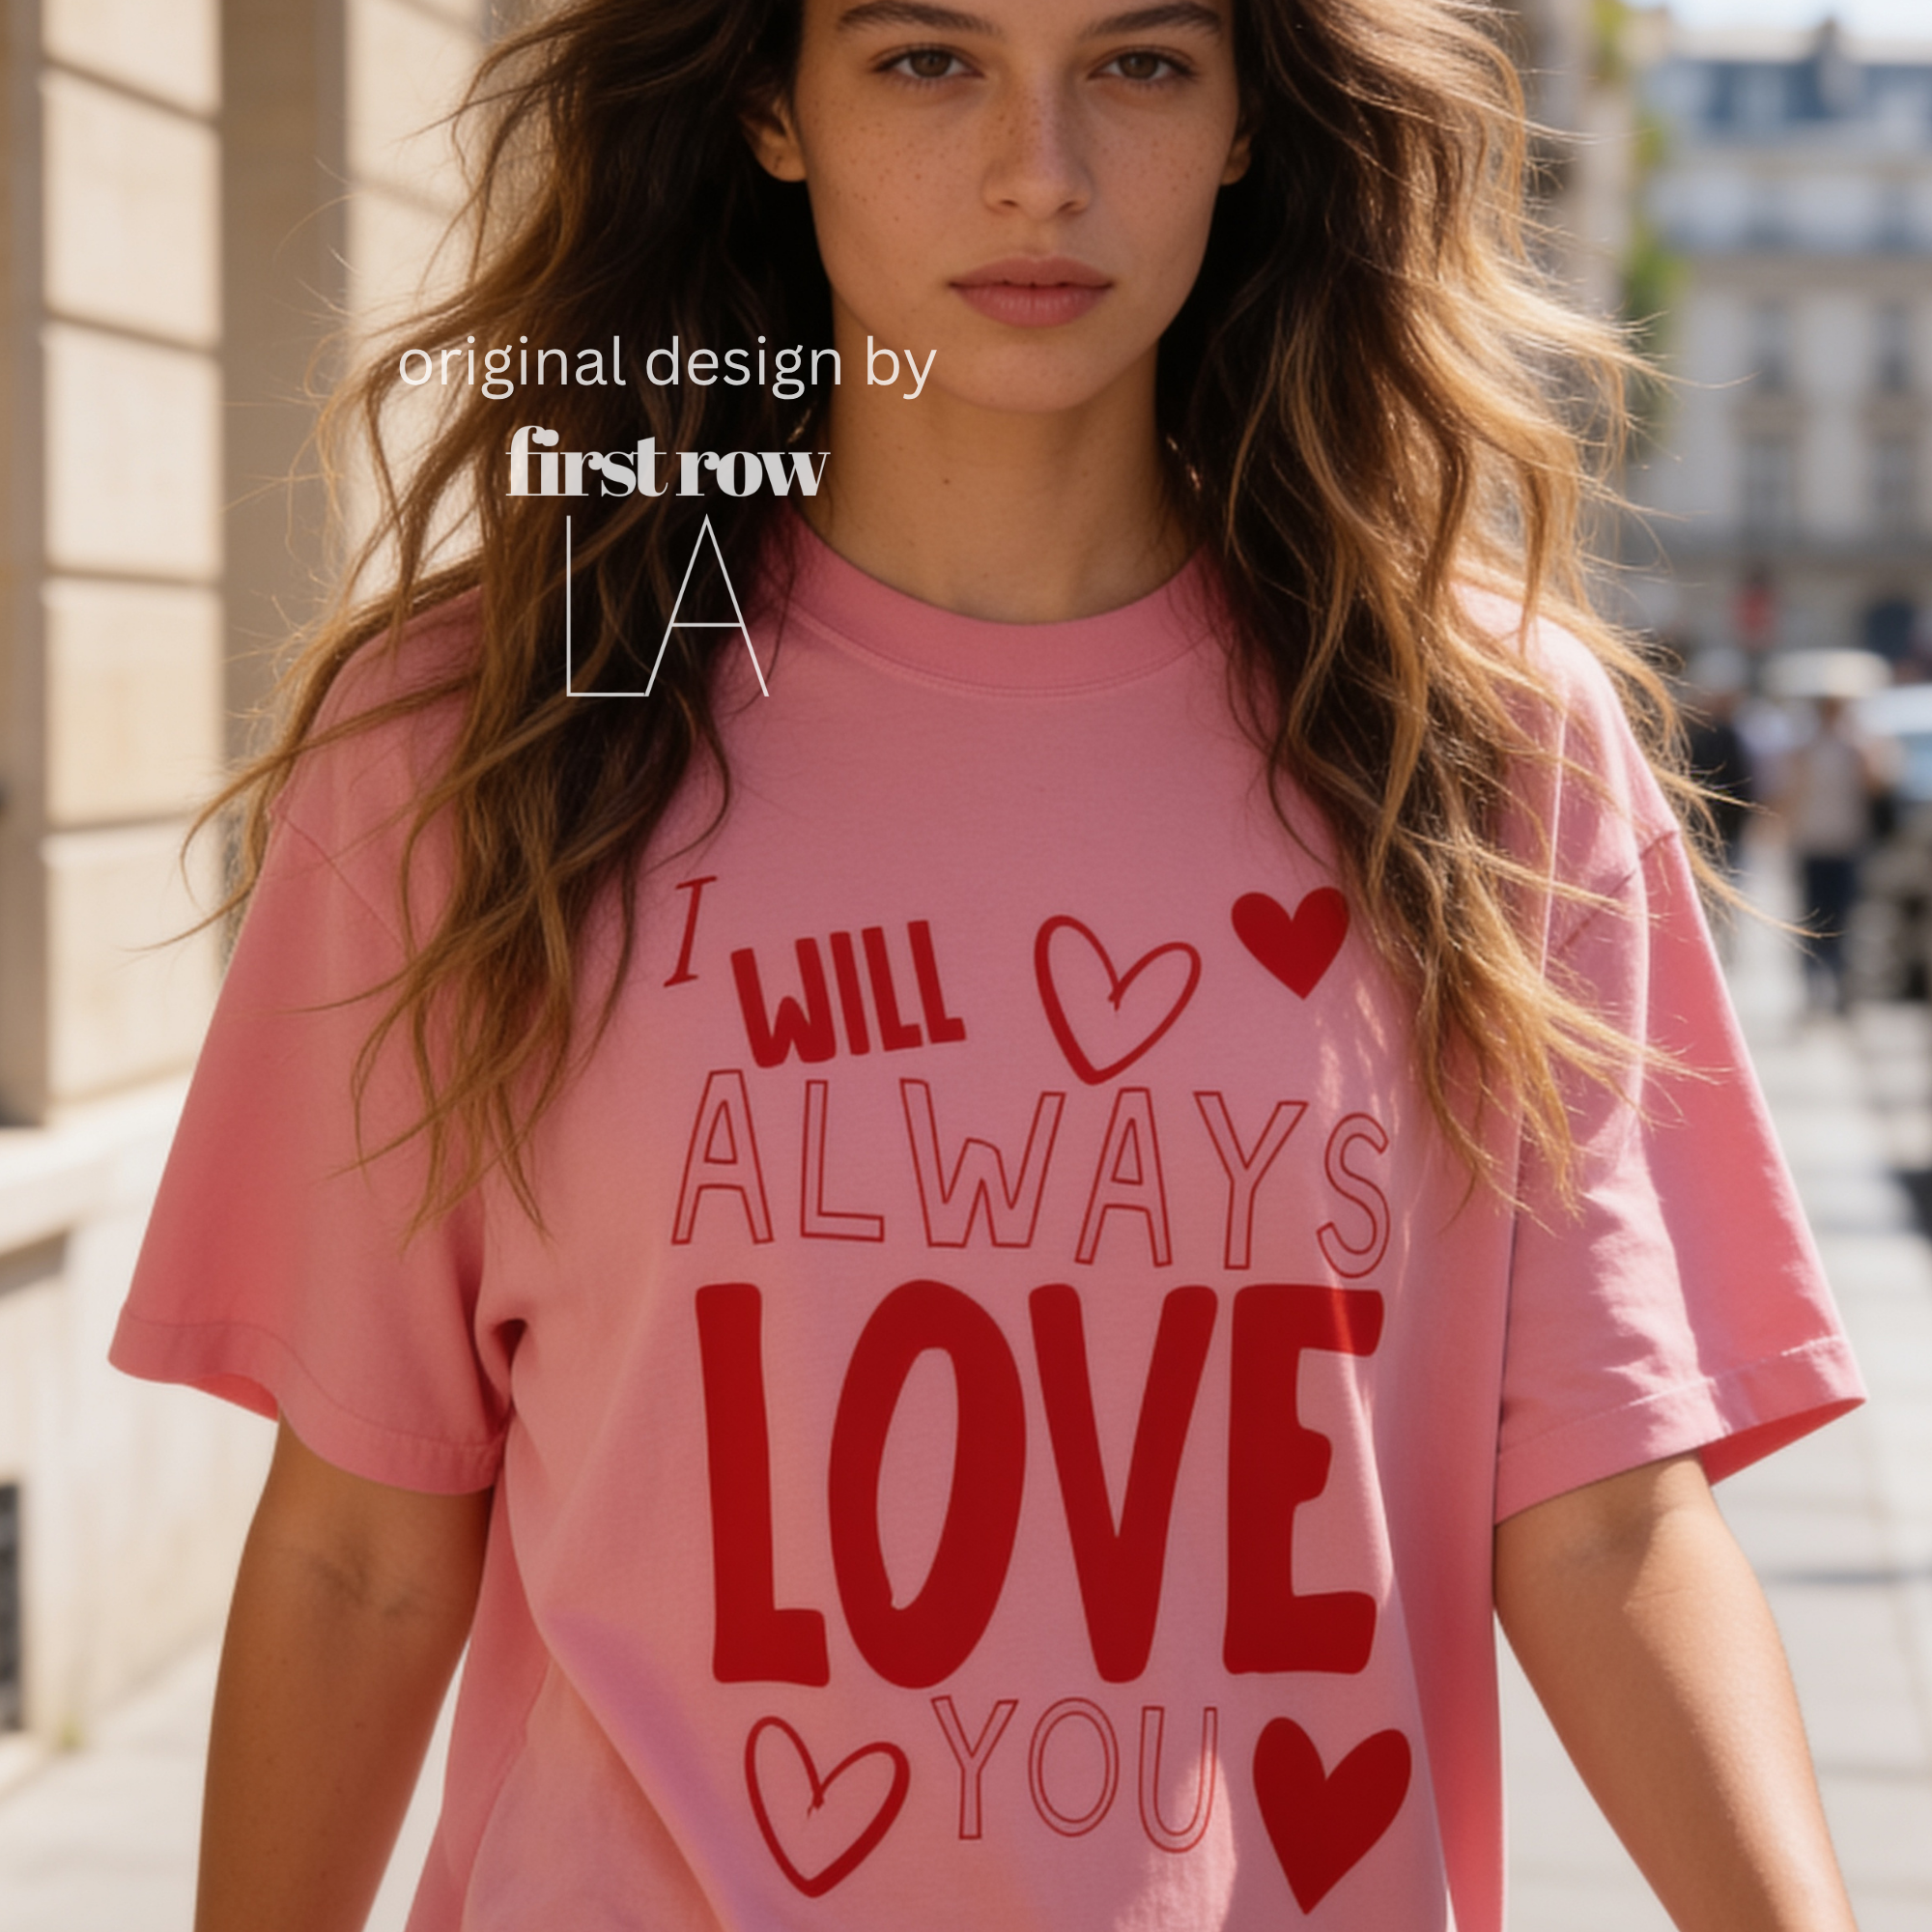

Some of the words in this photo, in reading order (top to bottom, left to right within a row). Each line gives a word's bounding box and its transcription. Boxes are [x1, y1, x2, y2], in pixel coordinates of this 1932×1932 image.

[664, 875, 718, 987] I
[730, 919, 966, 1069] WILL
[670, 1068, 1391, 1278] ALWAYS
[695, 1279, 1384, 1689] LOVE
[930, 1695, 1218, 1854] YOU
